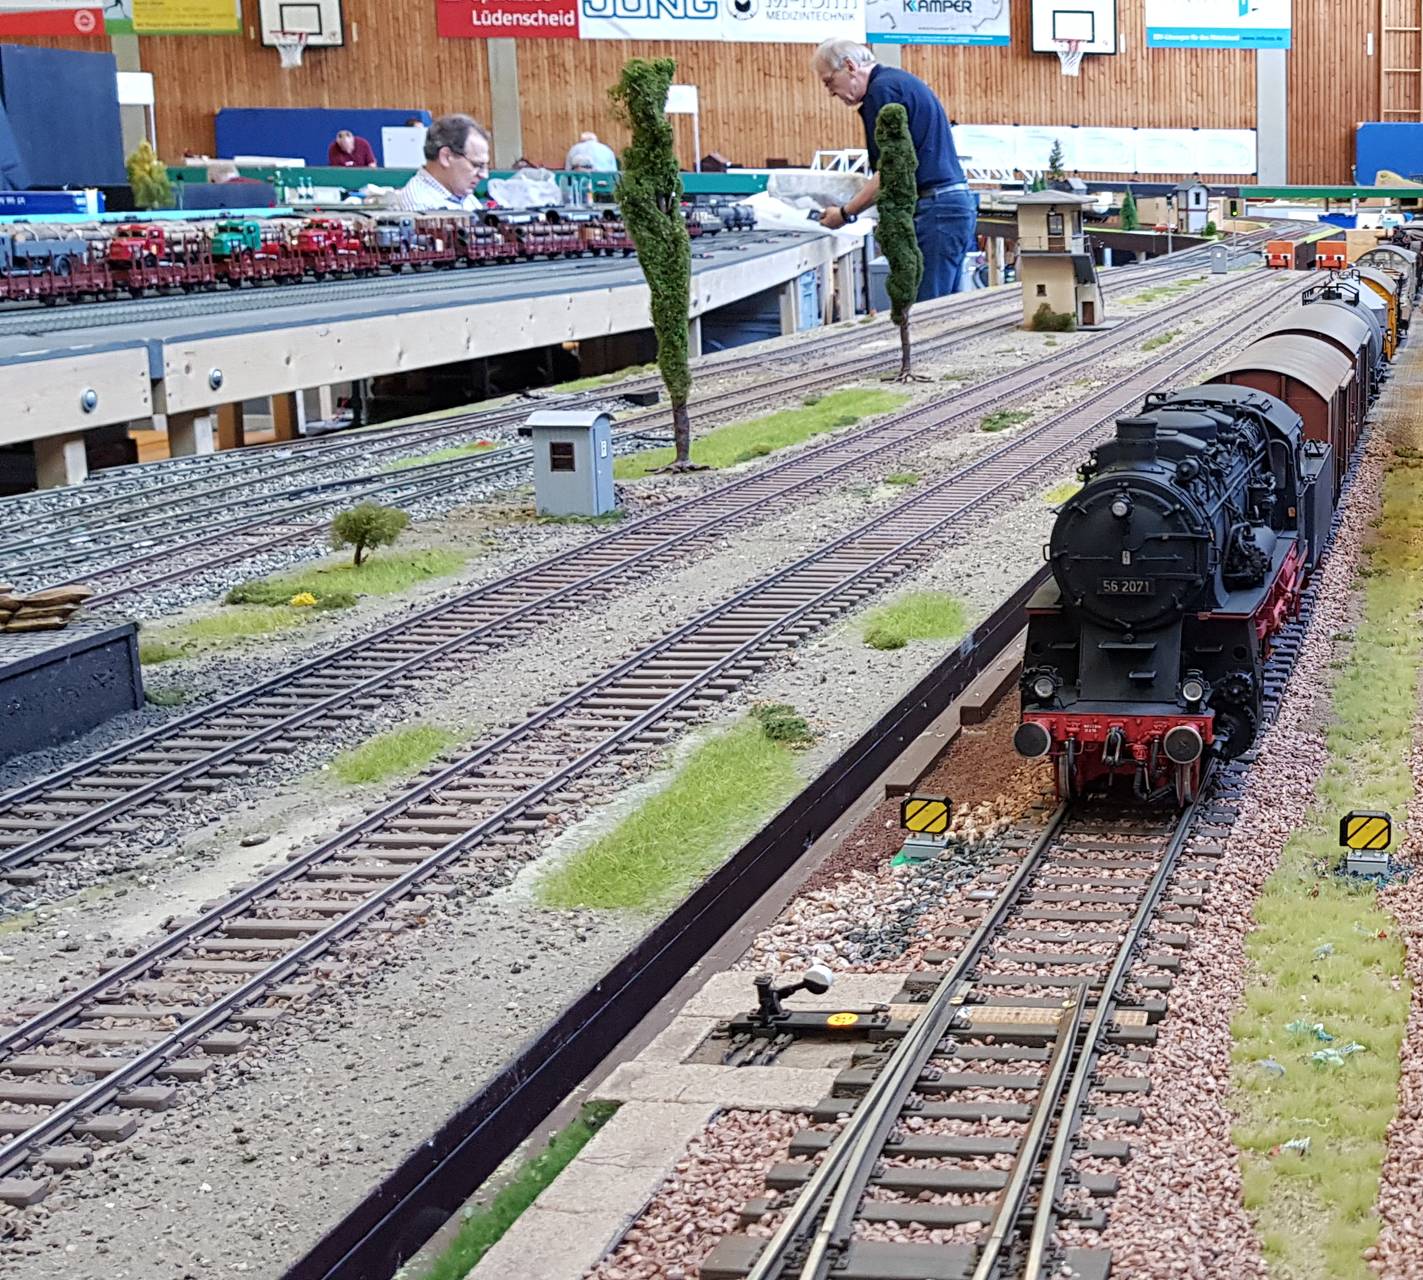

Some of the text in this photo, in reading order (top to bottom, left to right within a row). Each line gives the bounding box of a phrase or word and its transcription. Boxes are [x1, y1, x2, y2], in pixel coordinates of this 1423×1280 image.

[582, 0, 718, 19] JUNG
[765, 11, 856, 21] MEDIZINTECHNIK
[471, 9, 575, 27] Lüdenscheid
[1103, 580, 1150, 593] 56 2071
